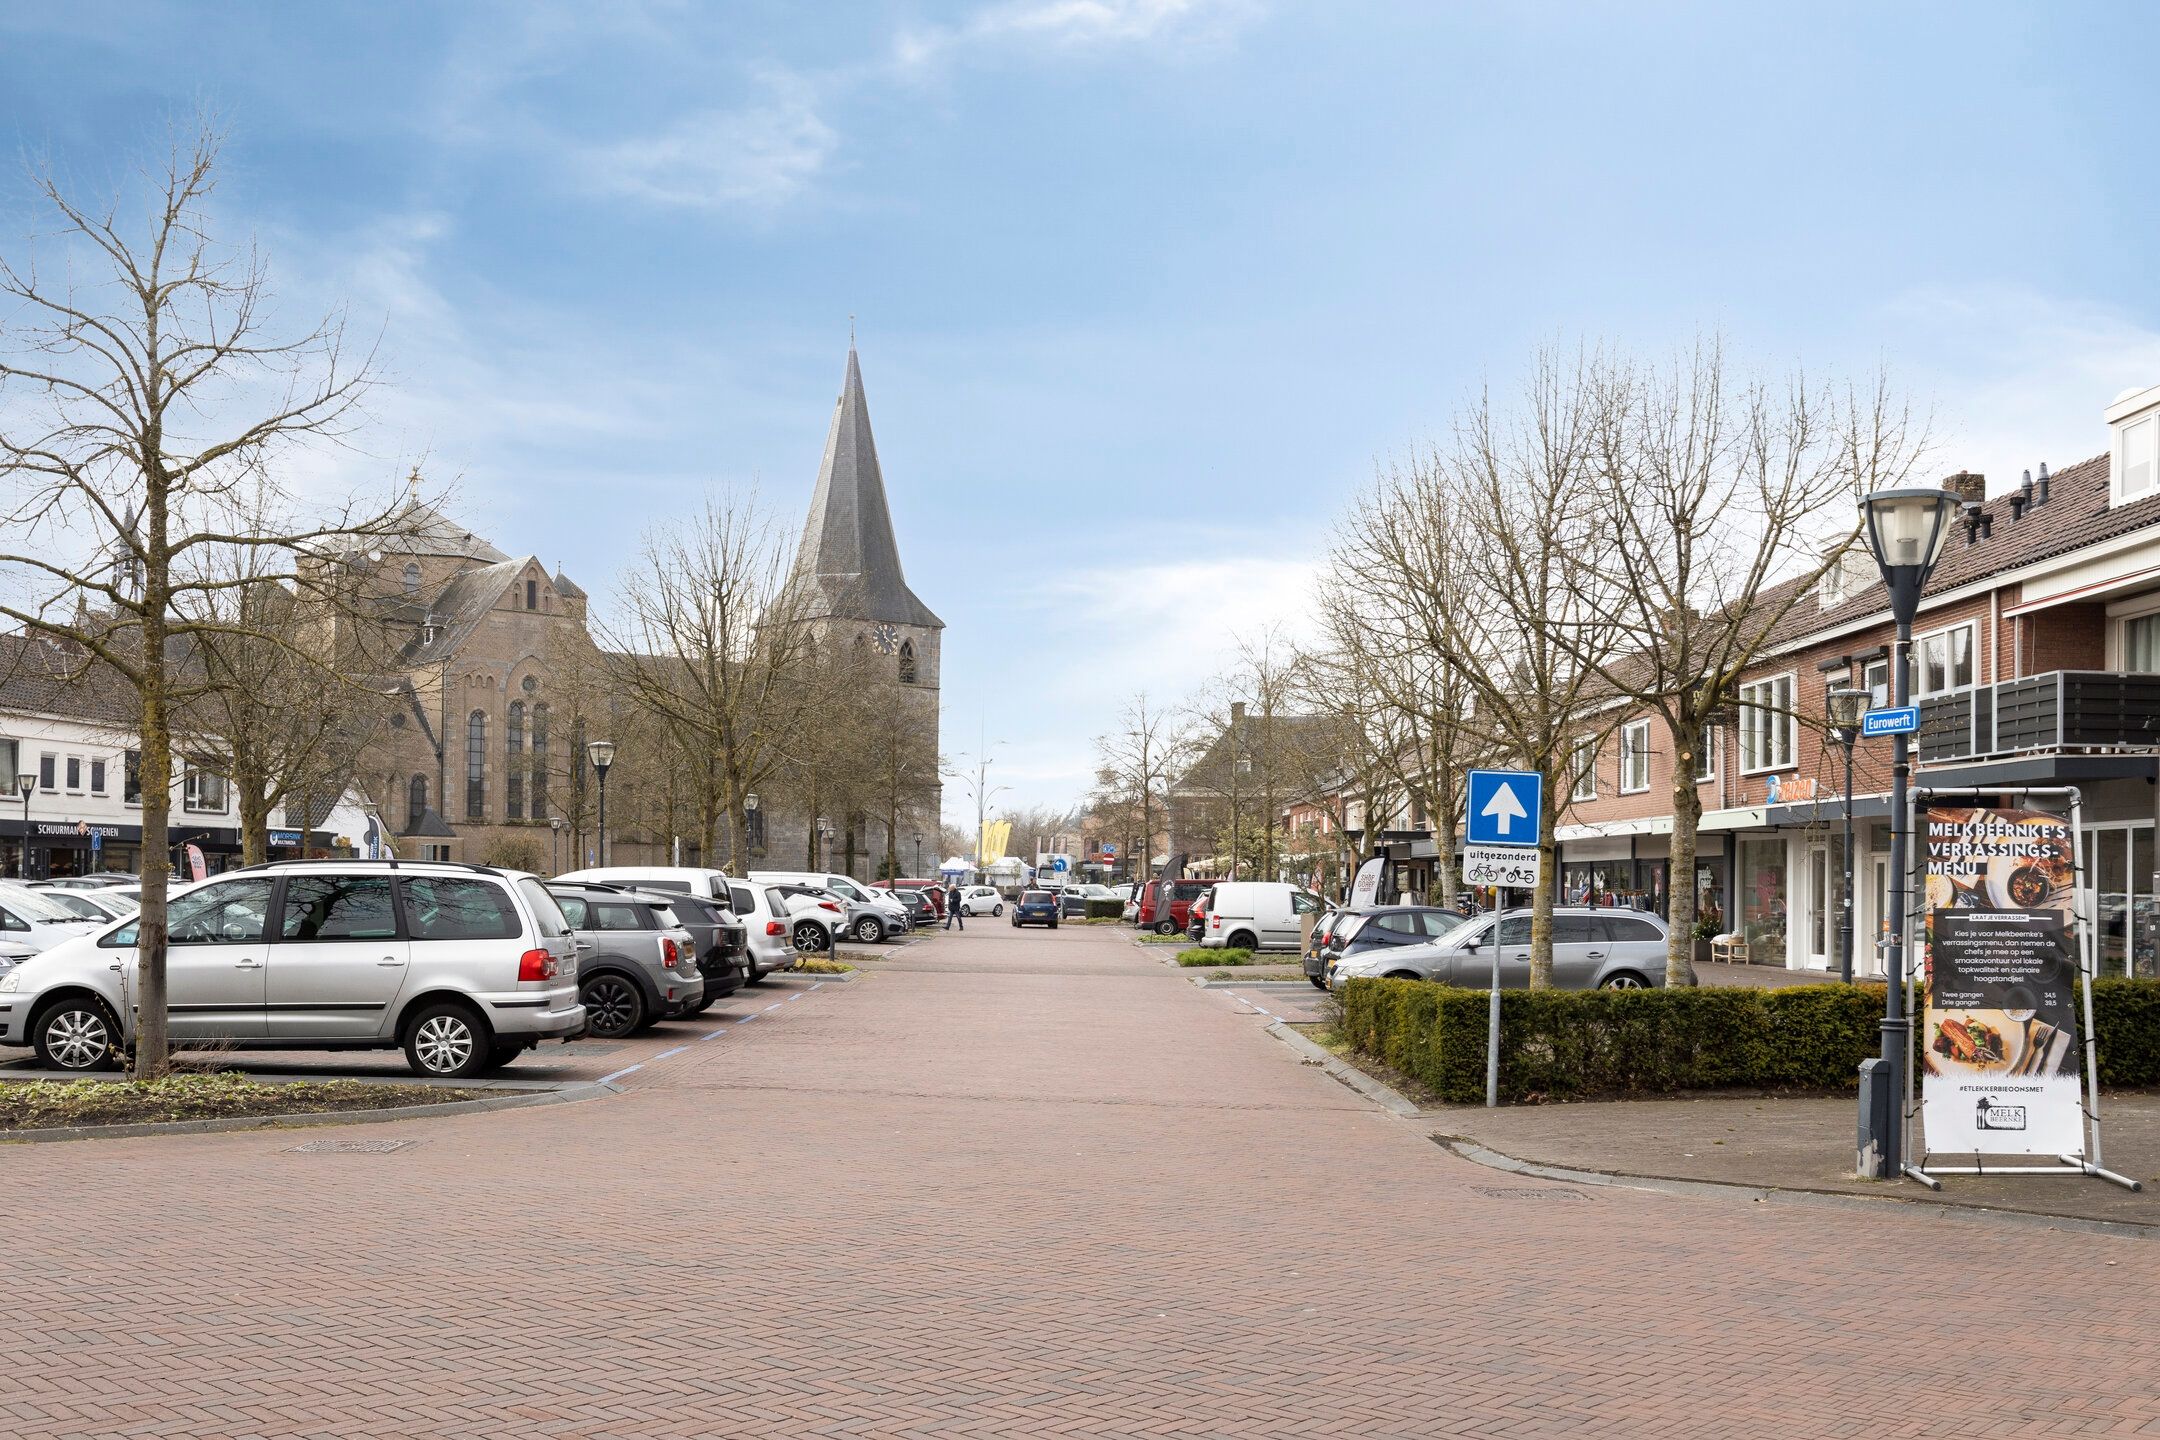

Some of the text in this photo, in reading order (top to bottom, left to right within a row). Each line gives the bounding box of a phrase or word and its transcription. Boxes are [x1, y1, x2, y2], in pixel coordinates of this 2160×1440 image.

[1869, 714, 1911, 730] Eurowerft
[38, 824, 79, 835] SCHUURMAN
[1928, 842, 2059, 858] VERRASSINGS-
[1470, 851, 1537, 862] uitgezonderd
[1927, 861, 1977, 875] MENU
[1990, 1109, 2021, 1117] MELK
